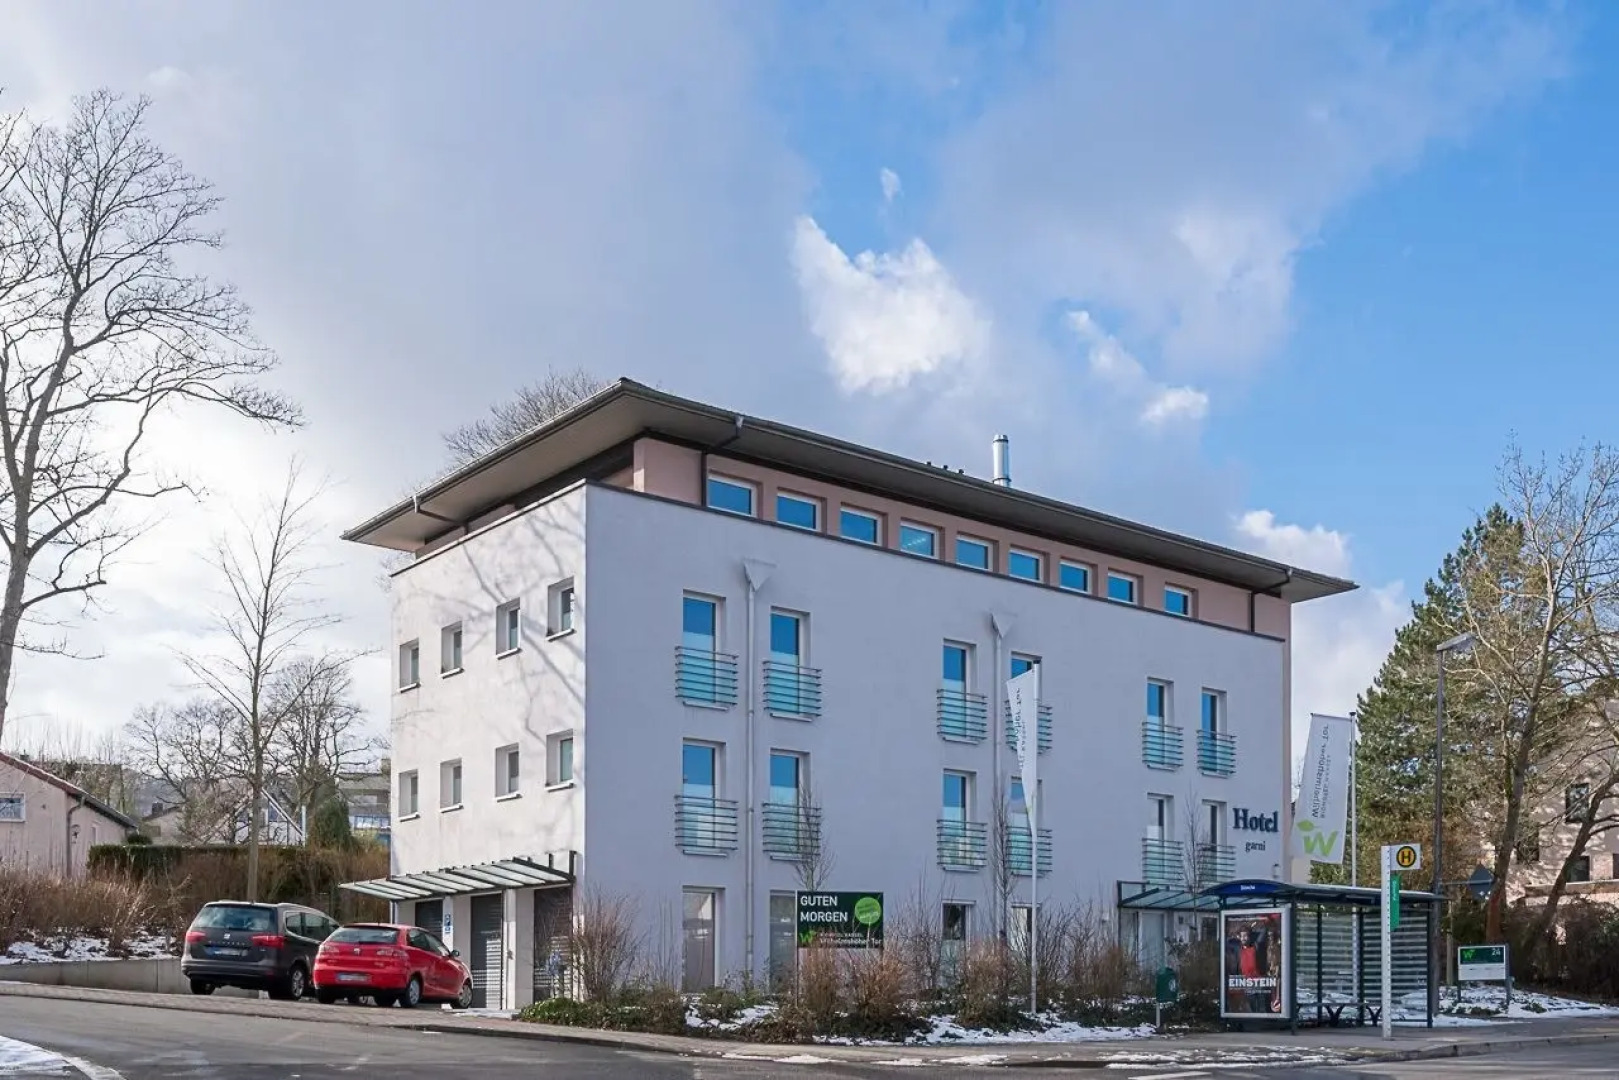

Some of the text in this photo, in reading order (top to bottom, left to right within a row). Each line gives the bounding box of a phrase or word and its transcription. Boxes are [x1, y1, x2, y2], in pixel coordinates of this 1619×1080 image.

[1232, 807, 1279, 833] Hotel
[1245, 840, 1266, 853] garni
[1402, 850, 1411, 864] H
[800, 895, 838, 906] GUTEN
[800, 911, 848, 922] MORGEN
[1228, 977, 1277, 988] EINSTEIN
